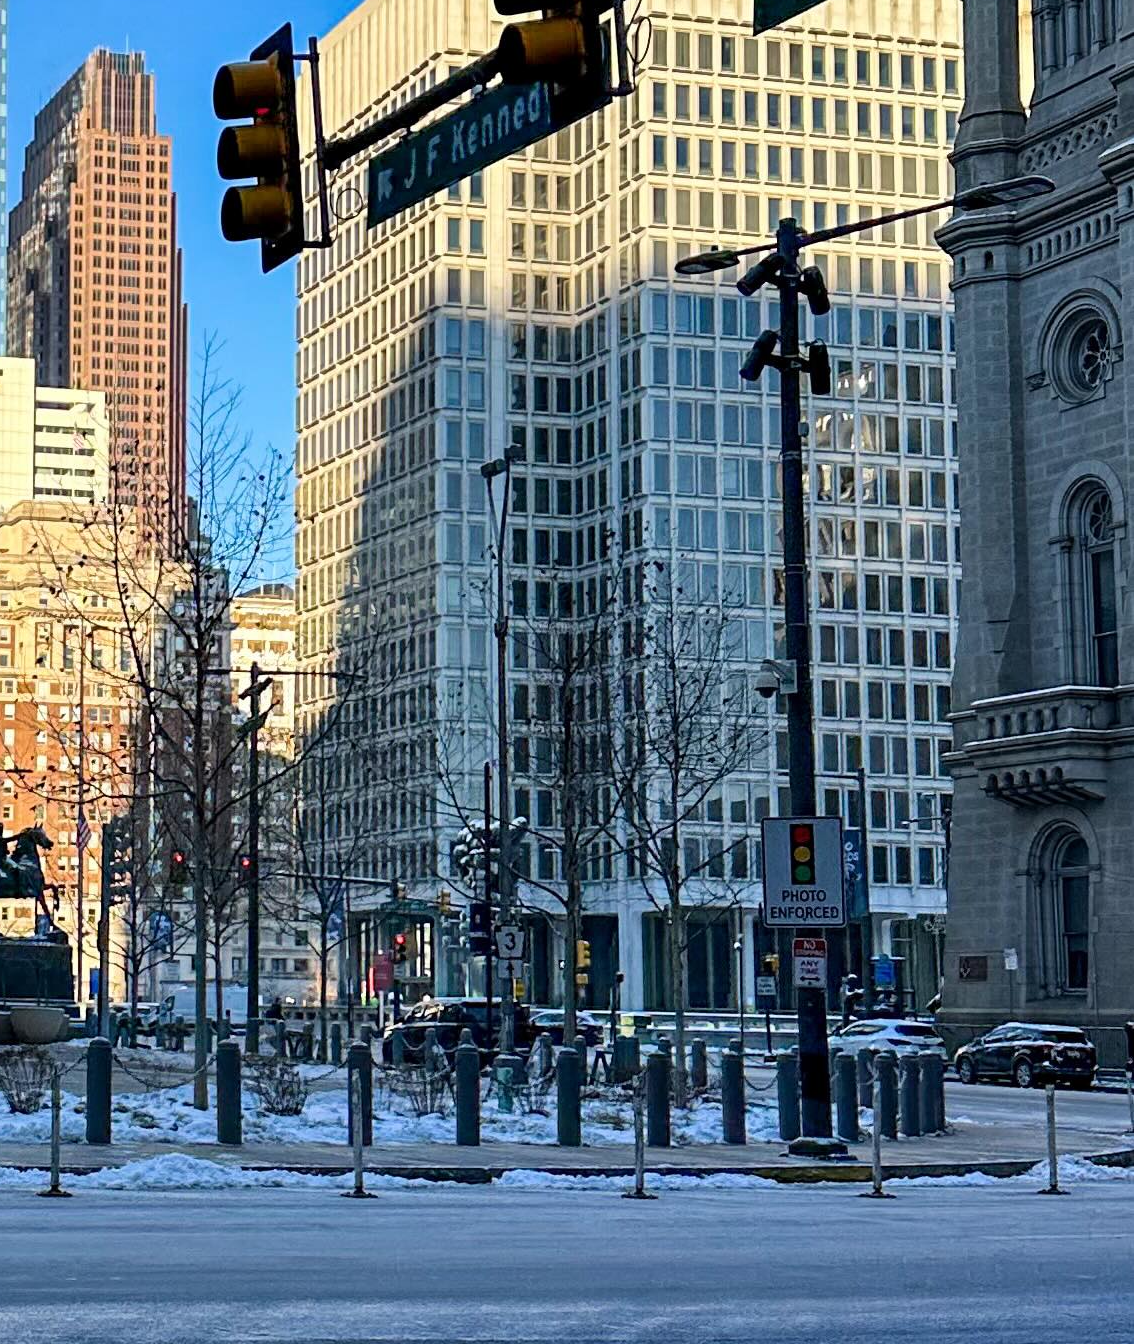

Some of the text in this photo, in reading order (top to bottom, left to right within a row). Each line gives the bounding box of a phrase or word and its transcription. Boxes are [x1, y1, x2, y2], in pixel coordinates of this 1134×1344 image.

[403, 148, 416, 188] J
[427, 134, 442, 177] F
[782, 889, 827, 902] PHOTO
[771, 906, 839, 919] ENFORCED
[505, 932, 516, 950] 3
[803, 940, 816, 950] NO
